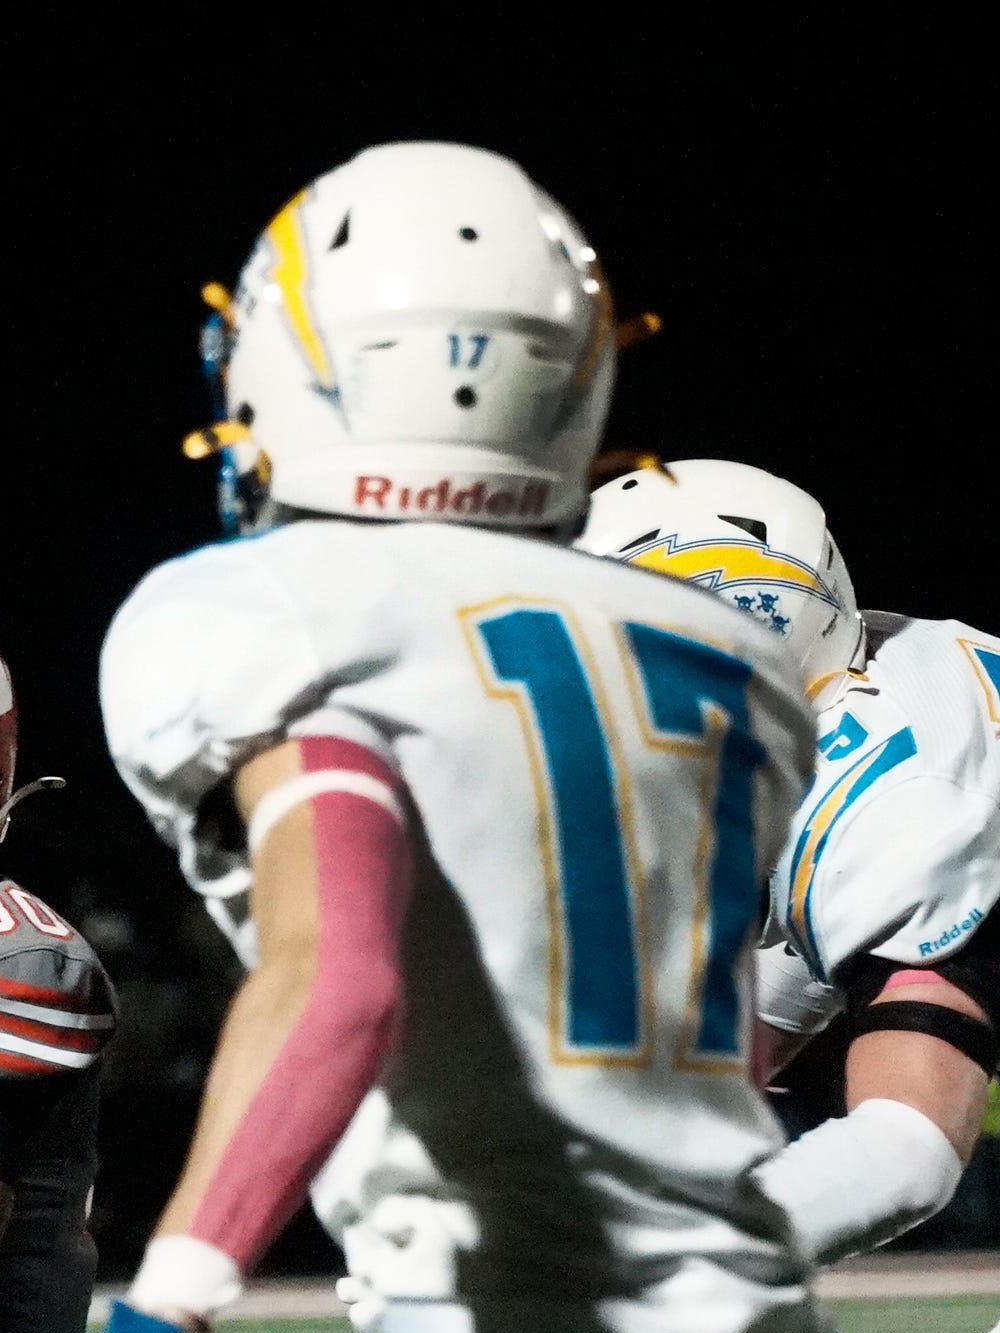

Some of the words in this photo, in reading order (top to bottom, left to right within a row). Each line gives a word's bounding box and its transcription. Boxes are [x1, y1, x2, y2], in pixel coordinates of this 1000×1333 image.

[447, 333, 490, 370] 17
[354, 474, 550, 517] Riddell
[457, 592, 766, 1078] 17
[918, 908, 984, 957] Riddell
